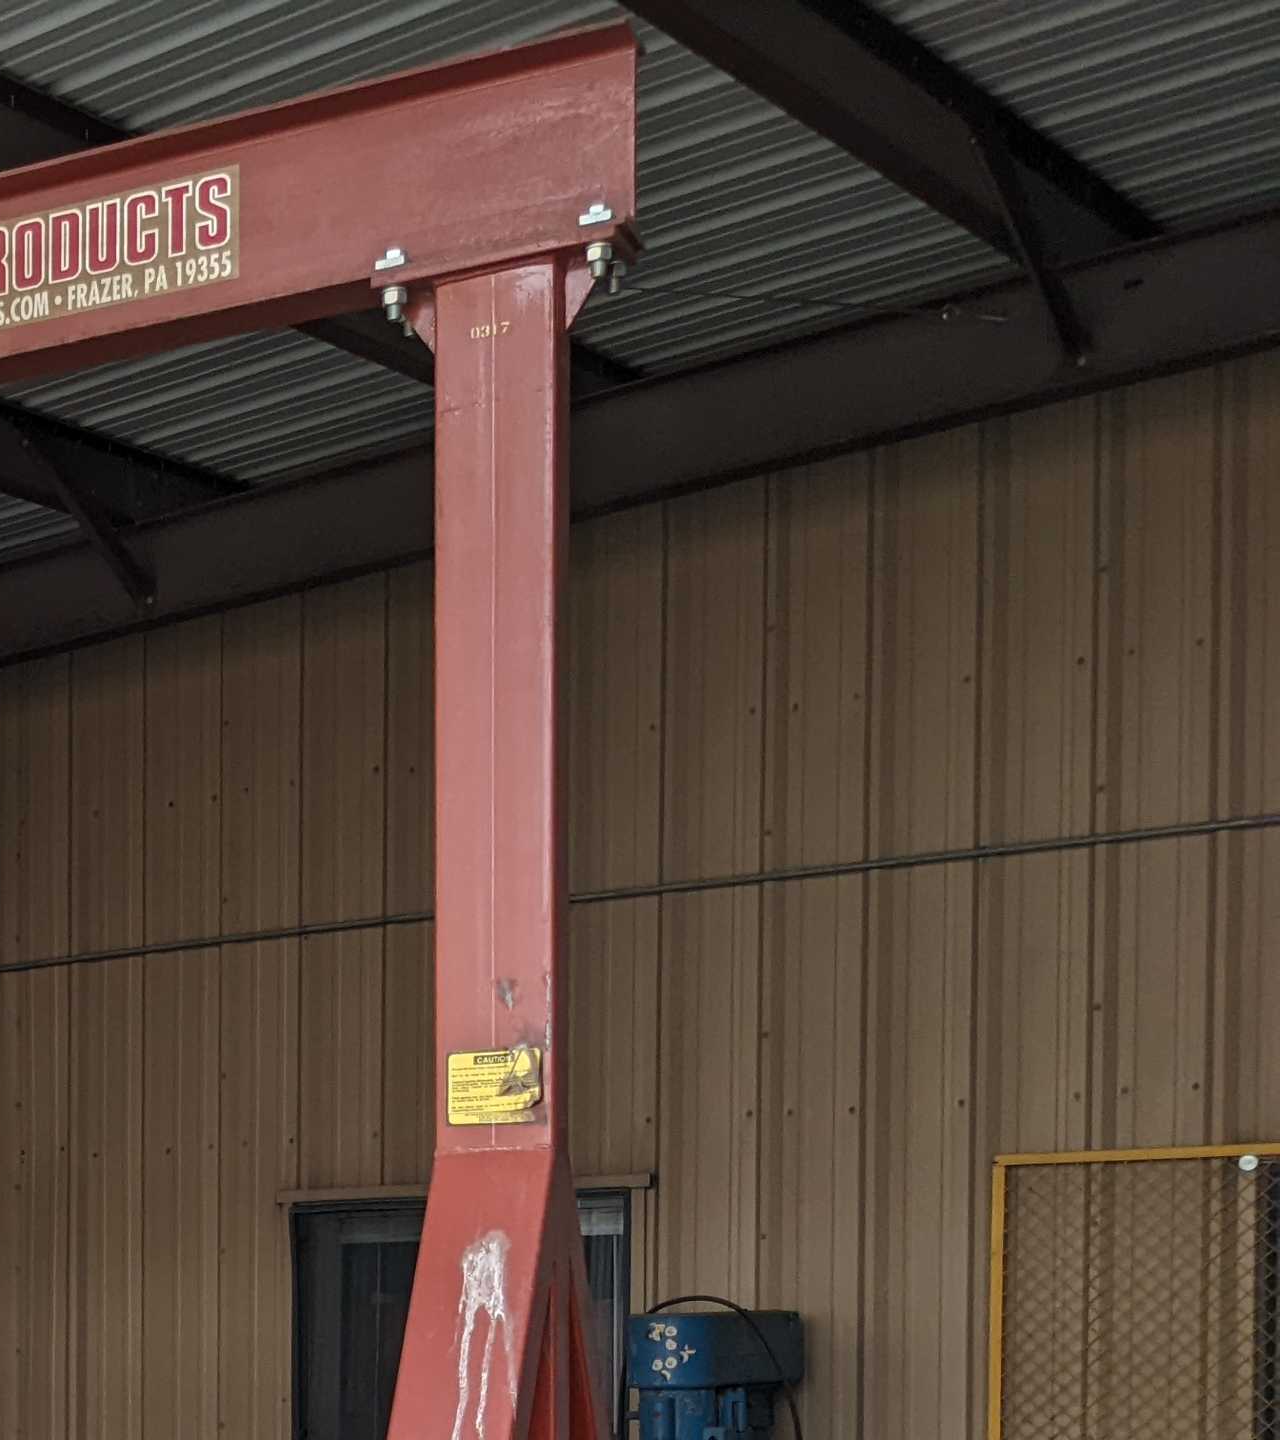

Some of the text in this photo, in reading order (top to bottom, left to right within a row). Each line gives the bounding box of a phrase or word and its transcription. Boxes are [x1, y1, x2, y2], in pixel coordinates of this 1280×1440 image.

[66, 272, 139, 311] FRAZER,
[144, 264, 169, 294] PA
[176, 251, 232, 285] 19355
